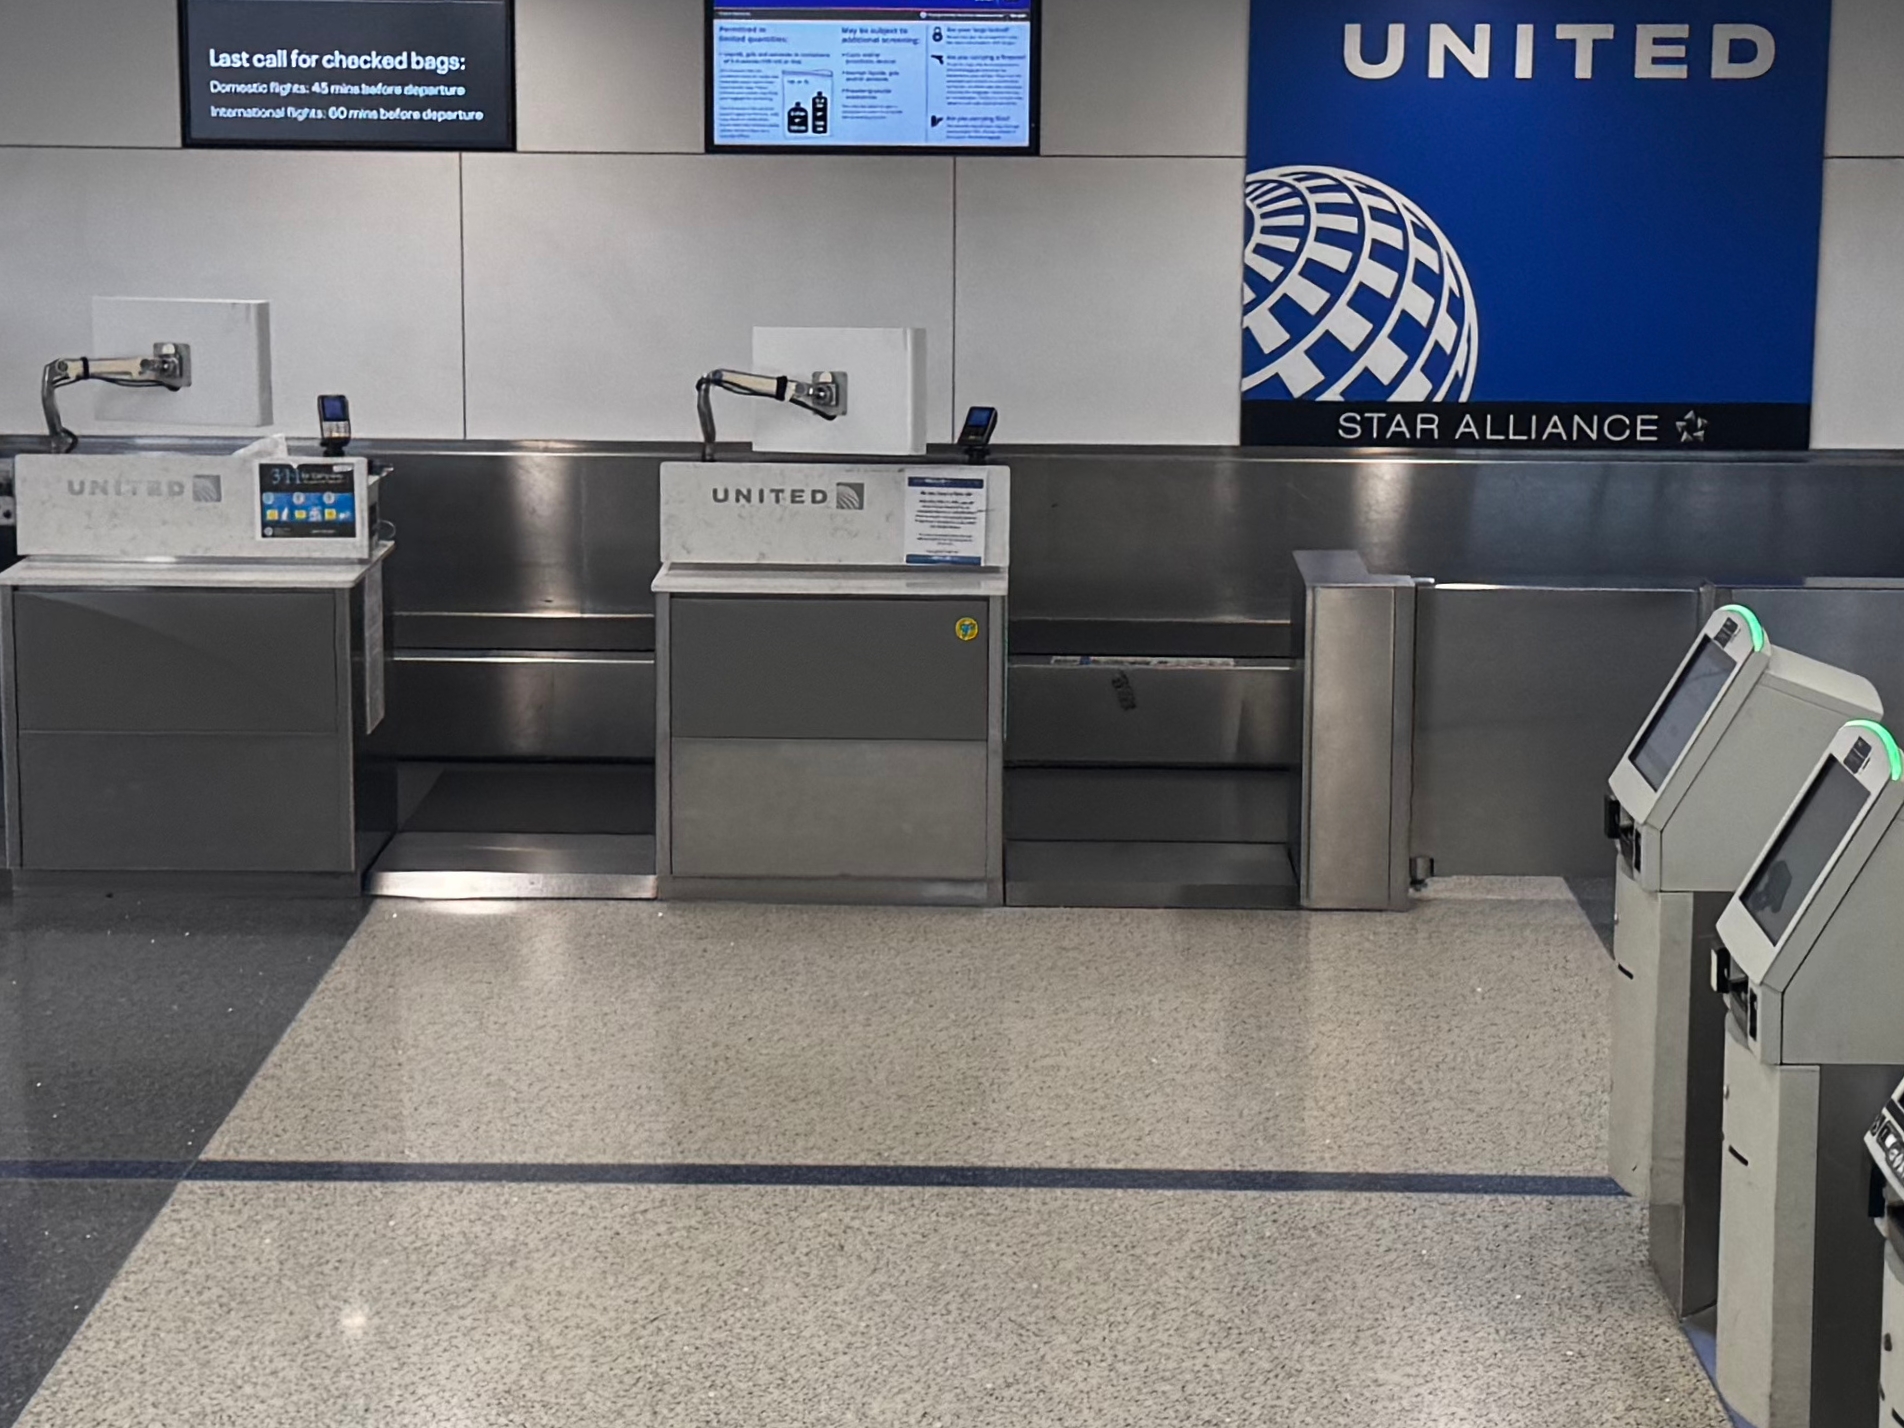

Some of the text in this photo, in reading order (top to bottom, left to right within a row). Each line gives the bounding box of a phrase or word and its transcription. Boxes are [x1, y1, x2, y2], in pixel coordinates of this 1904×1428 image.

[1342, 21, 1777, 80] UNITED
[209, 49, 466, 74] Last call for checked bags:
[209, 80, 466, 98] Domestic flights: 45 mins before departure
[210, 105, 484, 123] International flights: 60 mins before departure
[1337, 412, 1659, 441] STAR ALLIANCE
[67, 479, 185, 497] UNITED
[712, 487, 828, 505] UNITED
